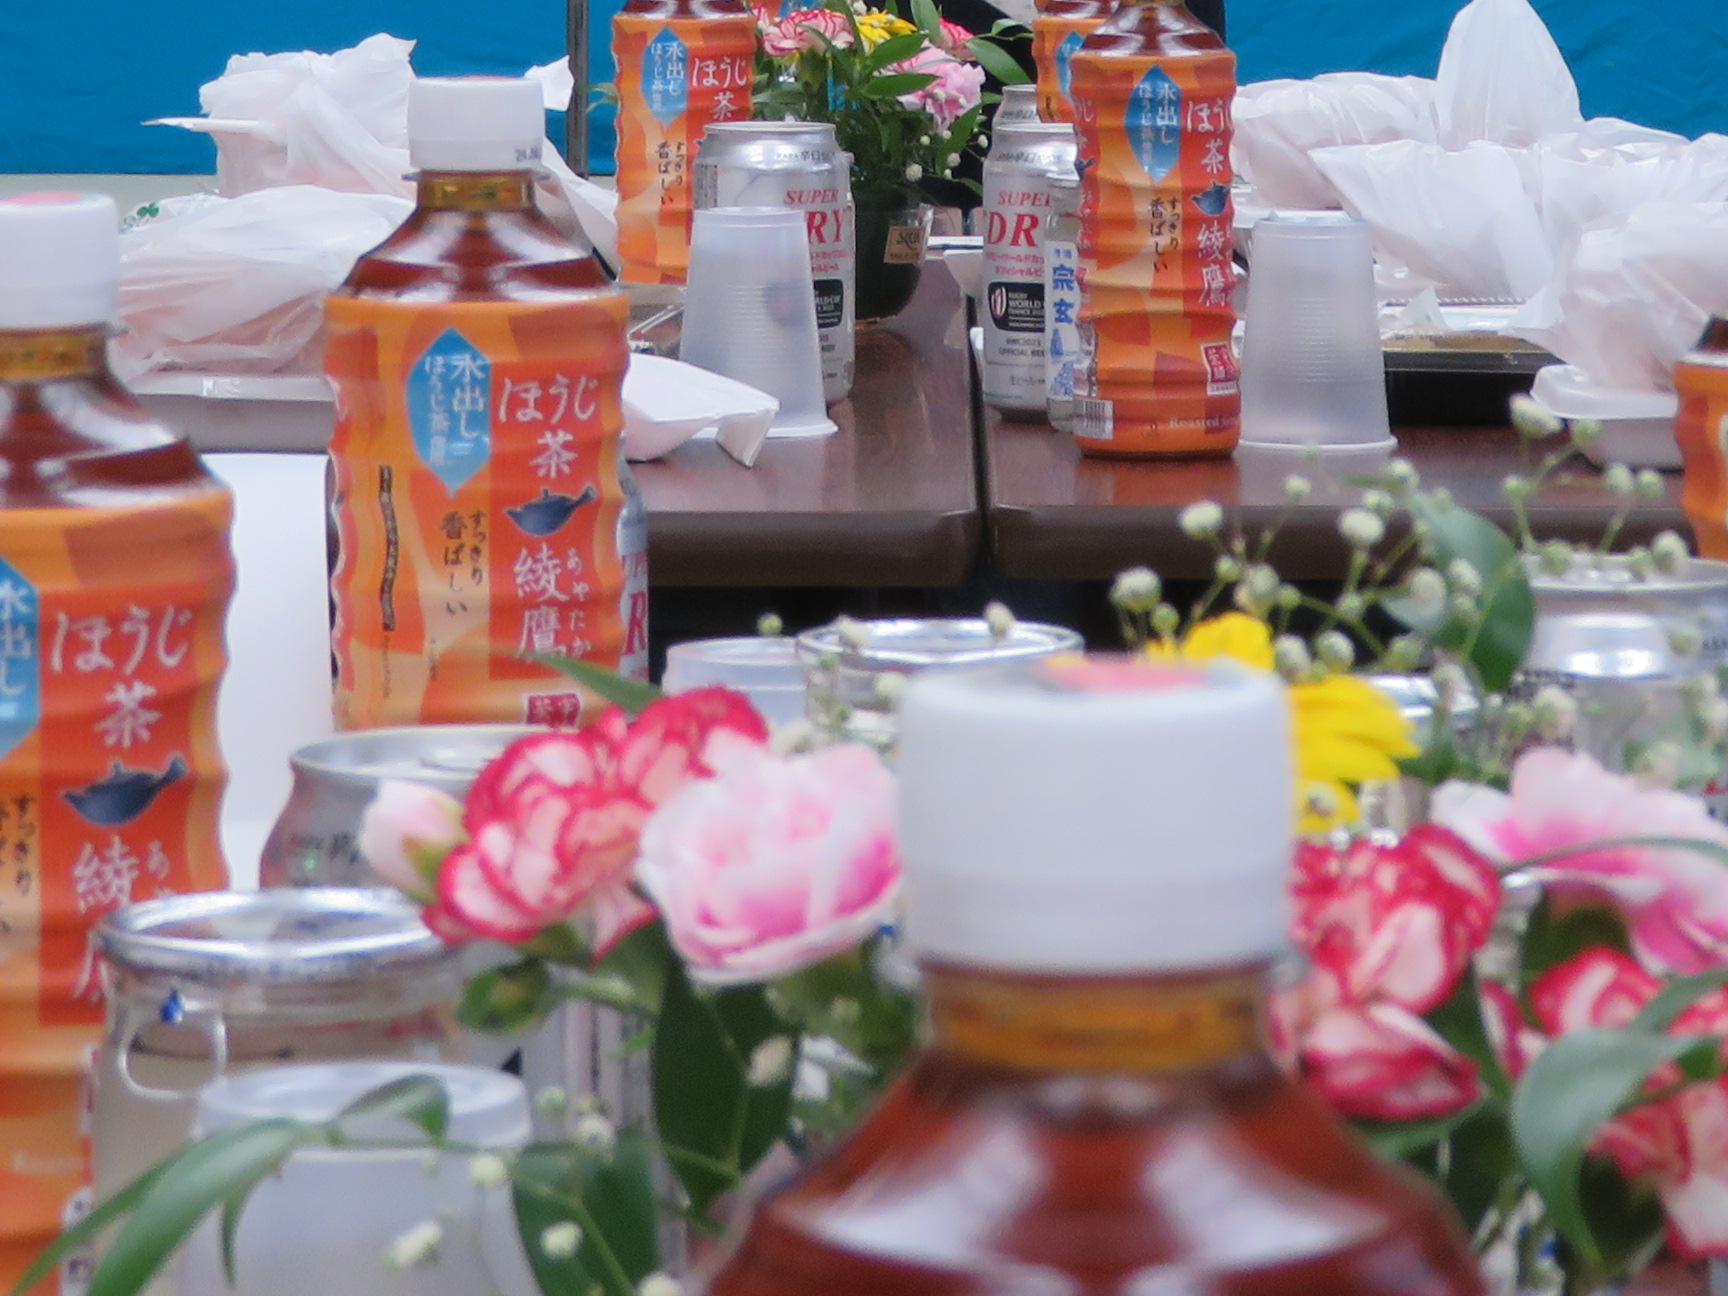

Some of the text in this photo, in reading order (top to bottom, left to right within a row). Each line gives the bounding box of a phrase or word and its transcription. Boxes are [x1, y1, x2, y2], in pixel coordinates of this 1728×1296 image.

[692, 57, 748, 88] ほうじ
[710, 91, 738, 120] 茶
[1156, 83, 1178, 144] 水出し
[655, 141, 674, 206] 香ばしい
[675, 141, 685, 186] すっきり
[1201, 139, 1226, 175] 茶
[784, 188, 839, 206] SUPER
[1168, 196, 1181, 249] すっきり
[806, 208, 849, 244] RY
[986, 212, 1041, 247] DR
[1149, 196, 1169, 273] 香ばしい
[1196, 220, 1227, 307] 綾鷹
[1008, 299, 1042, 308] WORLD
[1052, 264, 1076, 325] 宗玄
[451, 353, 485, 439] 水出し
[499, 374, 599, 424] ほうじ
[529, 430, 577, 479] 茶
[441, 510, 468, 616] 香ばしい
[468, 510, 487, 587] すっきり
[513, 541, 570, 659] 綾鷹
[50, 603, 193, 675] ほうじ
[94, 679, 163, 749] 茶
